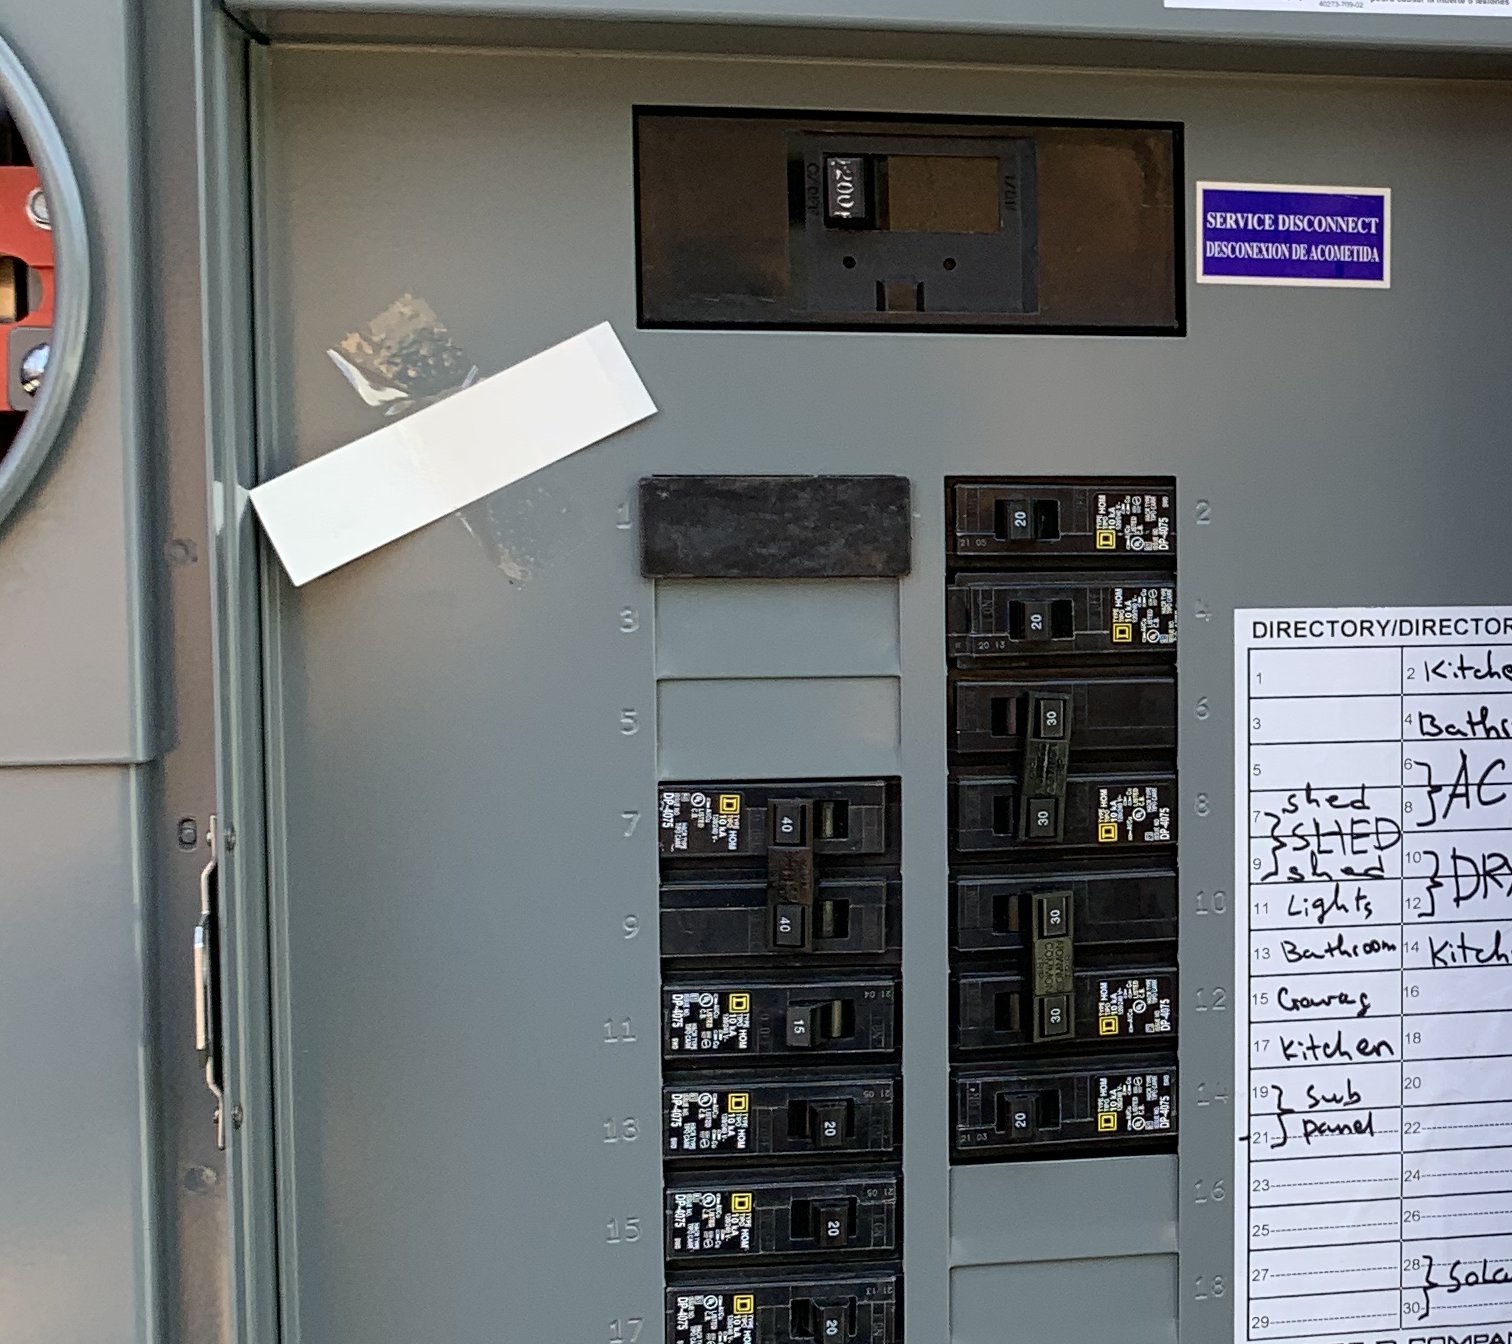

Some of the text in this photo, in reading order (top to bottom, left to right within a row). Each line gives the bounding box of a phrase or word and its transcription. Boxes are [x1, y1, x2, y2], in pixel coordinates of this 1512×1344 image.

[836, 170, 854, 207] 200
[1206, 211, 1379, 234] SERVICE DISCONNECT
[1205, 240, 1380, 263] DESCONEXION DE ACOMETIDA
[1015, 512, 1026, 526] 20
[1031, 615, 1041, 629] 20
[1406, 667, 1416, 680] 2
[1047, 711, 1057, 726] 30
[1404, 713, 1413, 725] 4
[1443, 749, 1507, 819] AC
[782, 817, 792, 832] 40
[1038, 812, 1048, 825] 30
[1292, 817, 1401, 856] SHED
[1050, 909, 1061, 924] 30
[780, 917, 790, 931] 40
[1254, 948, 1270, 959] 13
[1404, 941, 1420, 953] 14
[1195, 988, 1227, 1011] 12
[1051, 1009, 1060, 1023] 30
[603, 1018, 639, 1044] 11
[794, 1020, 804, 1033] 15
[1254, 1040, 1270, 1052] 17
[1404, 1077, 1421, 1090] 20
[1015, 1113, 1026, 1127] 20
[825, 1122, 836, 1136] 20
[1252, 1180, 1270, 1192] 23
[828, 1221, 839, 1235] 20
[826, 1320, 837, 1335] 20
